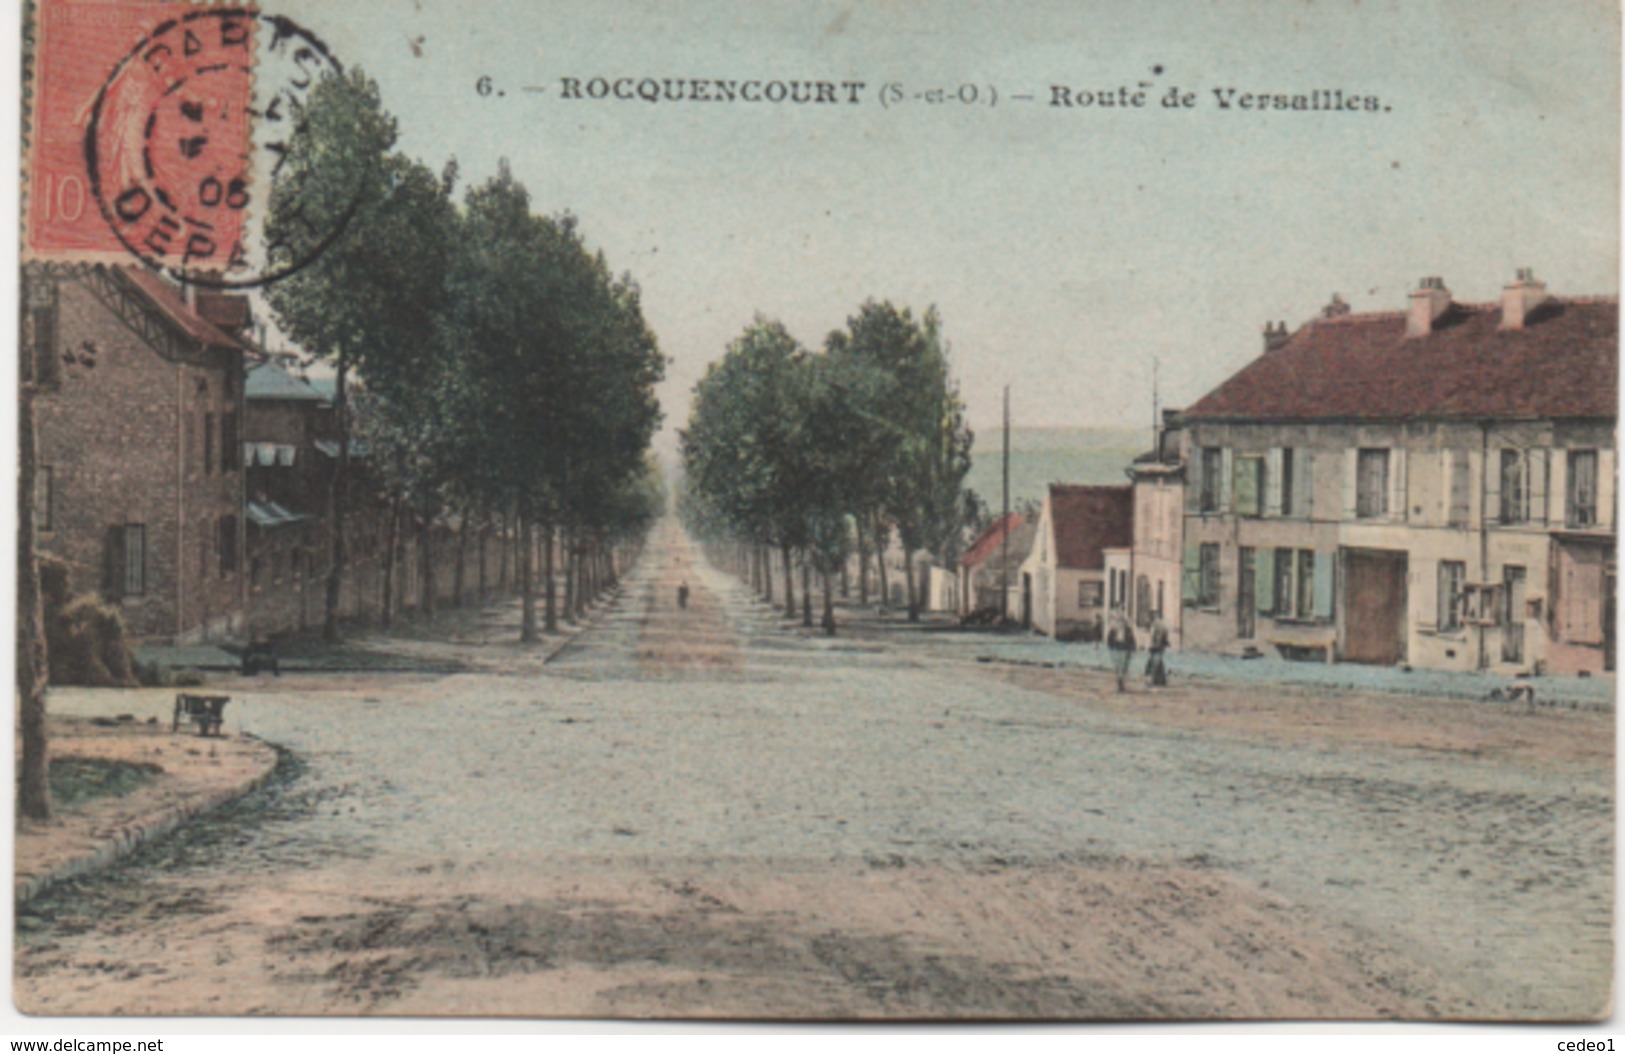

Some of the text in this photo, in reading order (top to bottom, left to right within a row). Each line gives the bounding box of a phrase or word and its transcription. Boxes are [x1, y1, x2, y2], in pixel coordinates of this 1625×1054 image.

[474, 75, 506, 98] 6.
[560, 77, 867, 105] ROCQUENCOURT
[1160, 86, 1197, 109] de
[1211, 87, 1393, 113] Versailles.
[38, 175, 86, 221] 10
